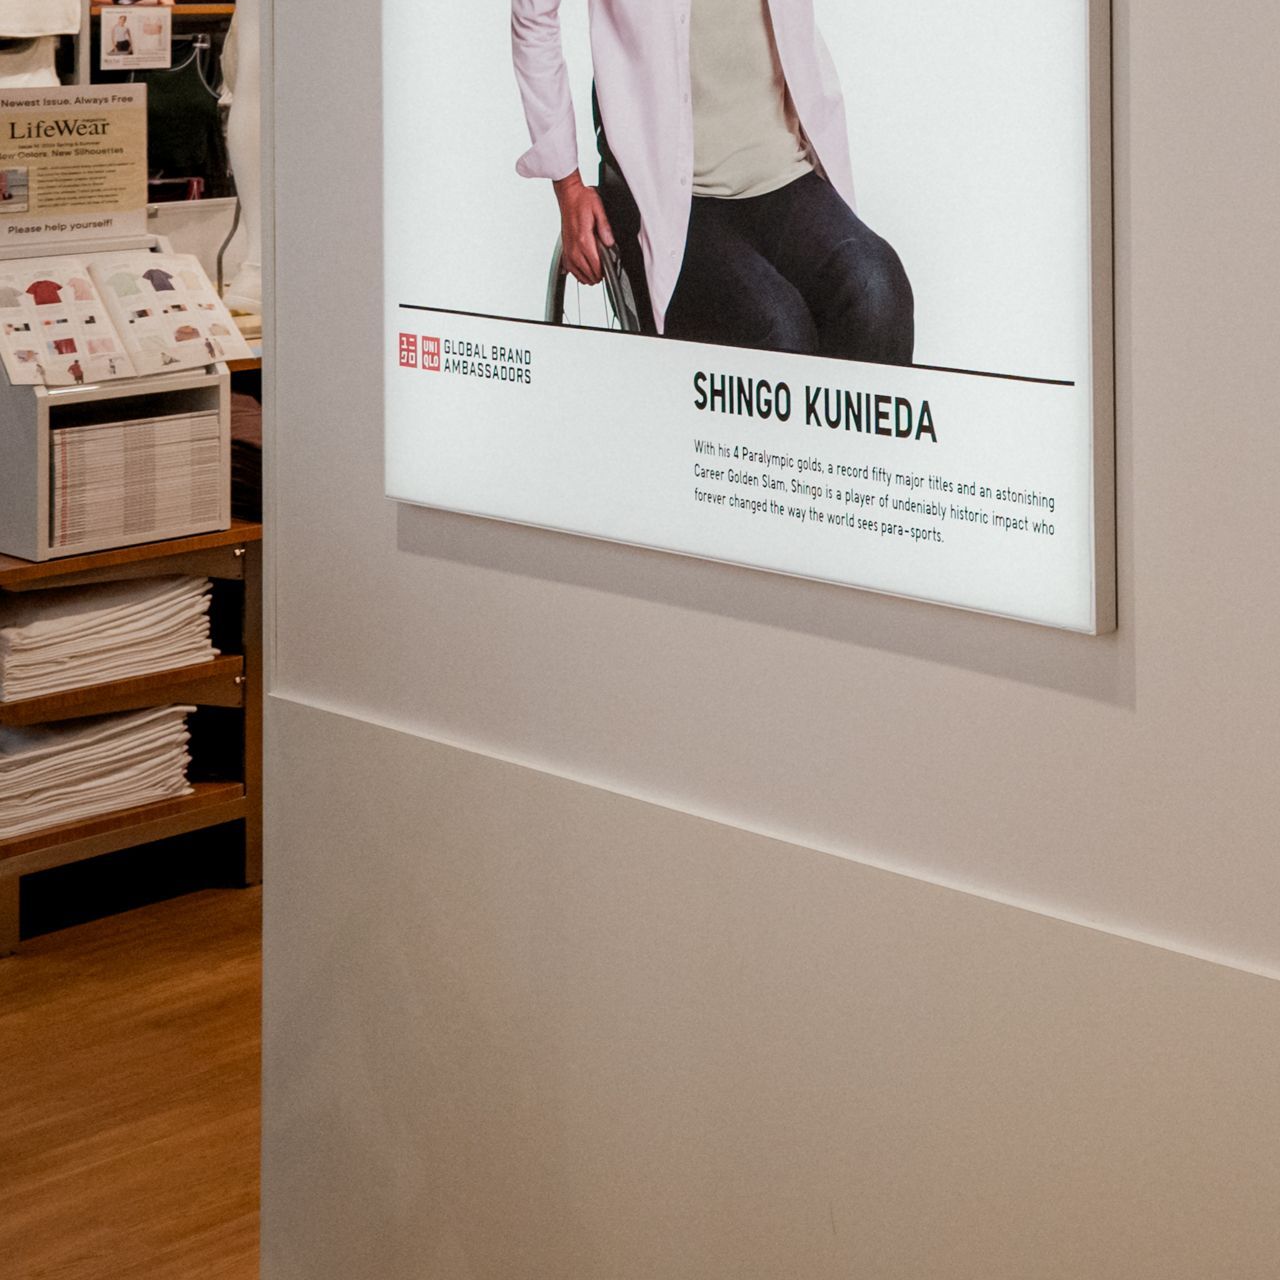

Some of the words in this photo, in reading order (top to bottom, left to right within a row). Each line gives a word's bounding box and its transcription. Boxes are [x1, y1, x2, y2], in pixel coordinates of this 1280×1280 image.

[1, 99, 40, 108] Newest
[75, 96, 109, 106] Always
[111, 95, 134, 103] Free
[9, 119, 111, 140] LifeWear
[51, 149, 72, 157] New
[74, 147, 124, 155] Silhouettes
[8, 226, 42, 234] Please
[44, 223, 67, 232] help
[70, 219, 113, 231] yourself!
[423, 340, 438, 354] UNI
[444, 339, 488, 360] GLOBAL
[491, 346, 532, 365] BRAND
[423, 355, 439, 368] QLO
[444, 358, 532, 384] AMBASSADORS
[693, 371, 792, 422] SHINGO
[805, 385, 938, 443] KUNIEDA
[693, 439, 715, 456] With
[718, 442, 730, 458] his
[733, 445, 739, 459] 4
[742, 446, 793, 470] Paralympic
[797, 456, 824, 474] golds,
[827, 463, 833, 474] a
[836, 464, 868, 480] record
[871, 466, 891, 487] fifty
[895, 471, 924, 490] major
[928, 474, 953, 493] titles
[956, 481, 975, 496] and
[979, 486, 991, 498] an
[995, 486, 1054, 513] astonishing
[693, 462, 724, 480] Career
[727, 468, 758, 486] Golden
[761, 473, 787, 492] Slam,
[790, 478, 822, 500] Shingo
[825, 484, 832, 499] is
[835, 489, 841, 500] a
[844, 488, 875, 508] player
[878, 493, 888, 508] of
[892, 497, 946, 521] undeniably
[950, 503, 988, 524] historic
[992, 510, 1028, 531] impact
[1032, 519, 1054, 535] who
[694, 487, 726, 505] forever
[728, 493, 767, 514] changed
[769, 499, 784, 515] the
[787, 506, 806, 522] way
[808, 506, 824, 522] the
[826, 512, 854, 528] world
[857, 518, 878, 532] sees
[880, 522, 944, 542] para-sports.
